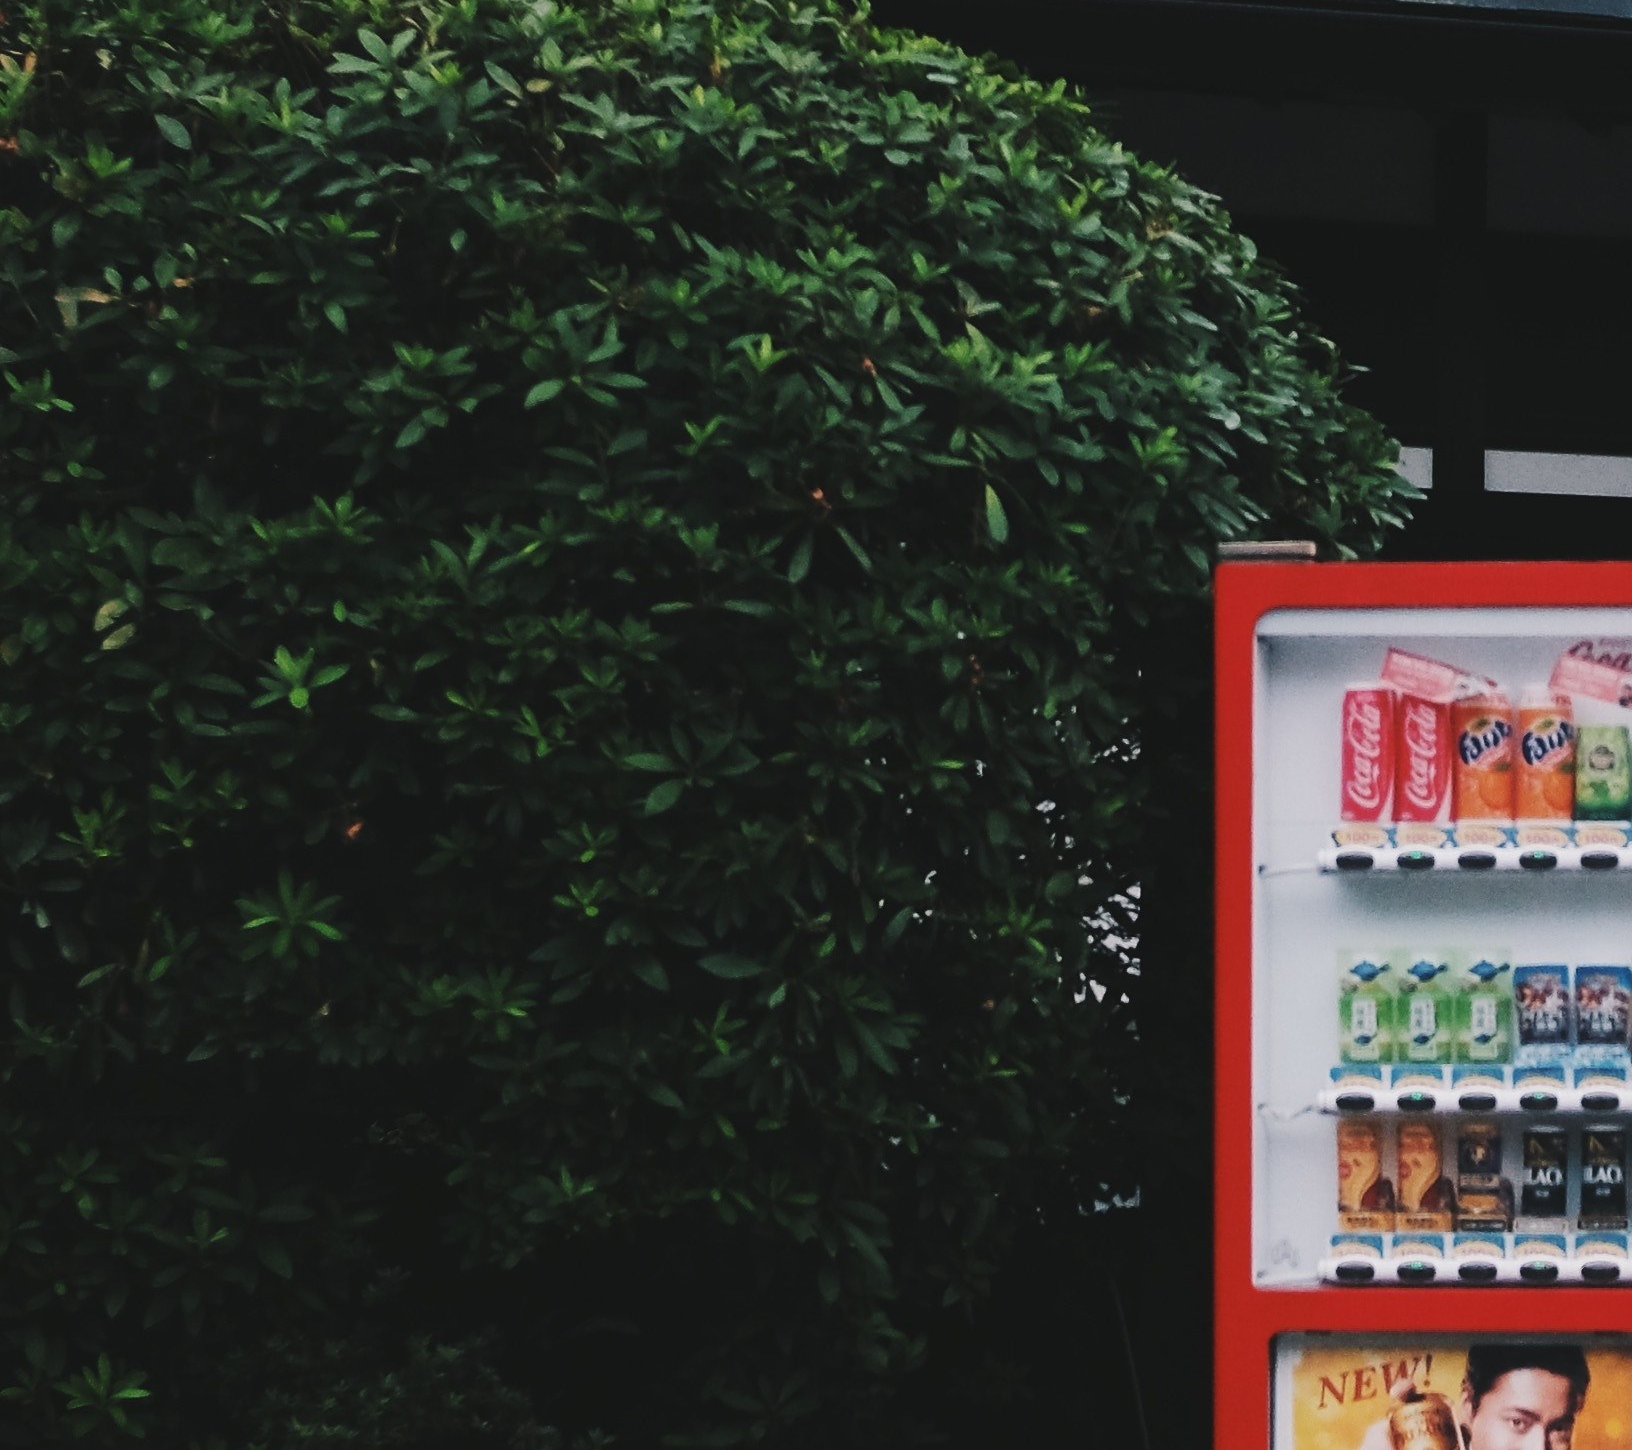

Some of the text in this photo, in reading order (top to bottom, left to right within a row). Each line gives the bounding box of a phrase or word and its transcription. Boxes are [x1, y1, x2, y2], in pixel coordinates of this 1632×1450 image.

[1348, 703, 1380, 809] Coca-Cola
[1405, 703, 1437, 809] Coca-Cola
[1318, 1353, 1433, 1408] NEW!
